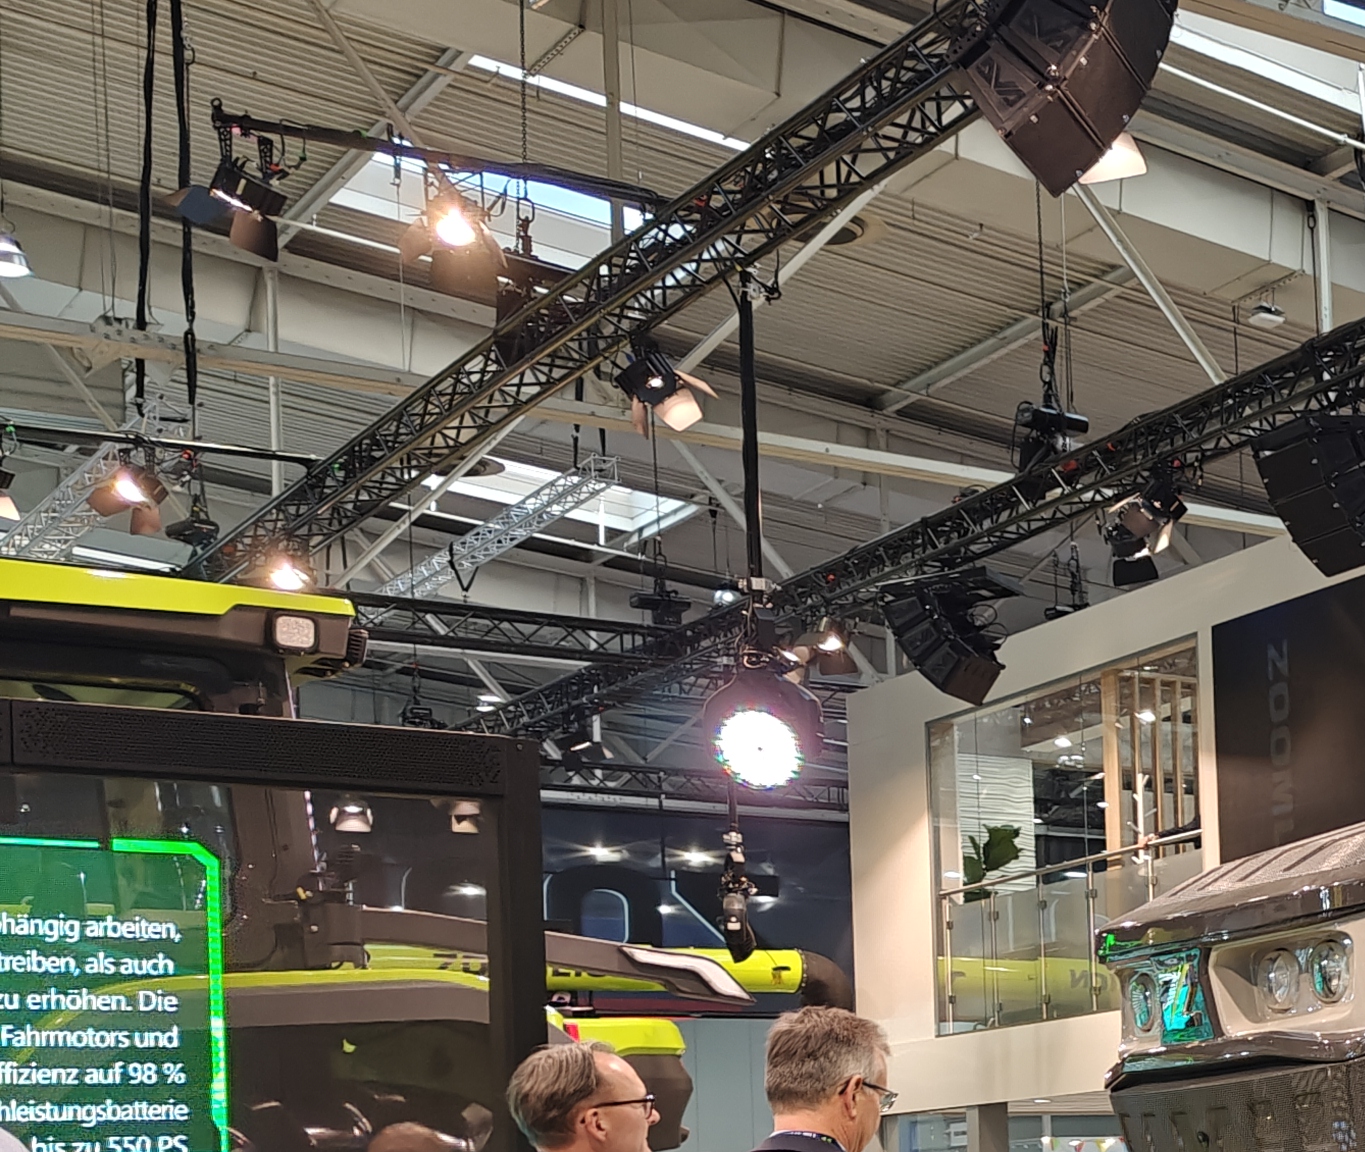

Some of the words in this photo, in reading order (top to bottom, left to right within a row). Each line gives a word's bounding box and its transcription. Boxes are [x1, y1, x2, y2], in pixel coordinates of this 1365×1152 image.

[0, 911, 81, 943] hängig
[85, 915, 183, 943] arbeiten,
[85, 952, 115, 975] als
[120, 952, 174, 975] auch
[26, 987, 133, 1011] erhöhen.
[139, 989, 179, 1012] Die
[0, 1023, 129, 1047] Fahrmotors
[133, 1024, 179, 1048] und
[84, 1061, 125, 1085] auf
[128, 1062, 158, 1085] 98
[162, 1062, 187, 1085] %
